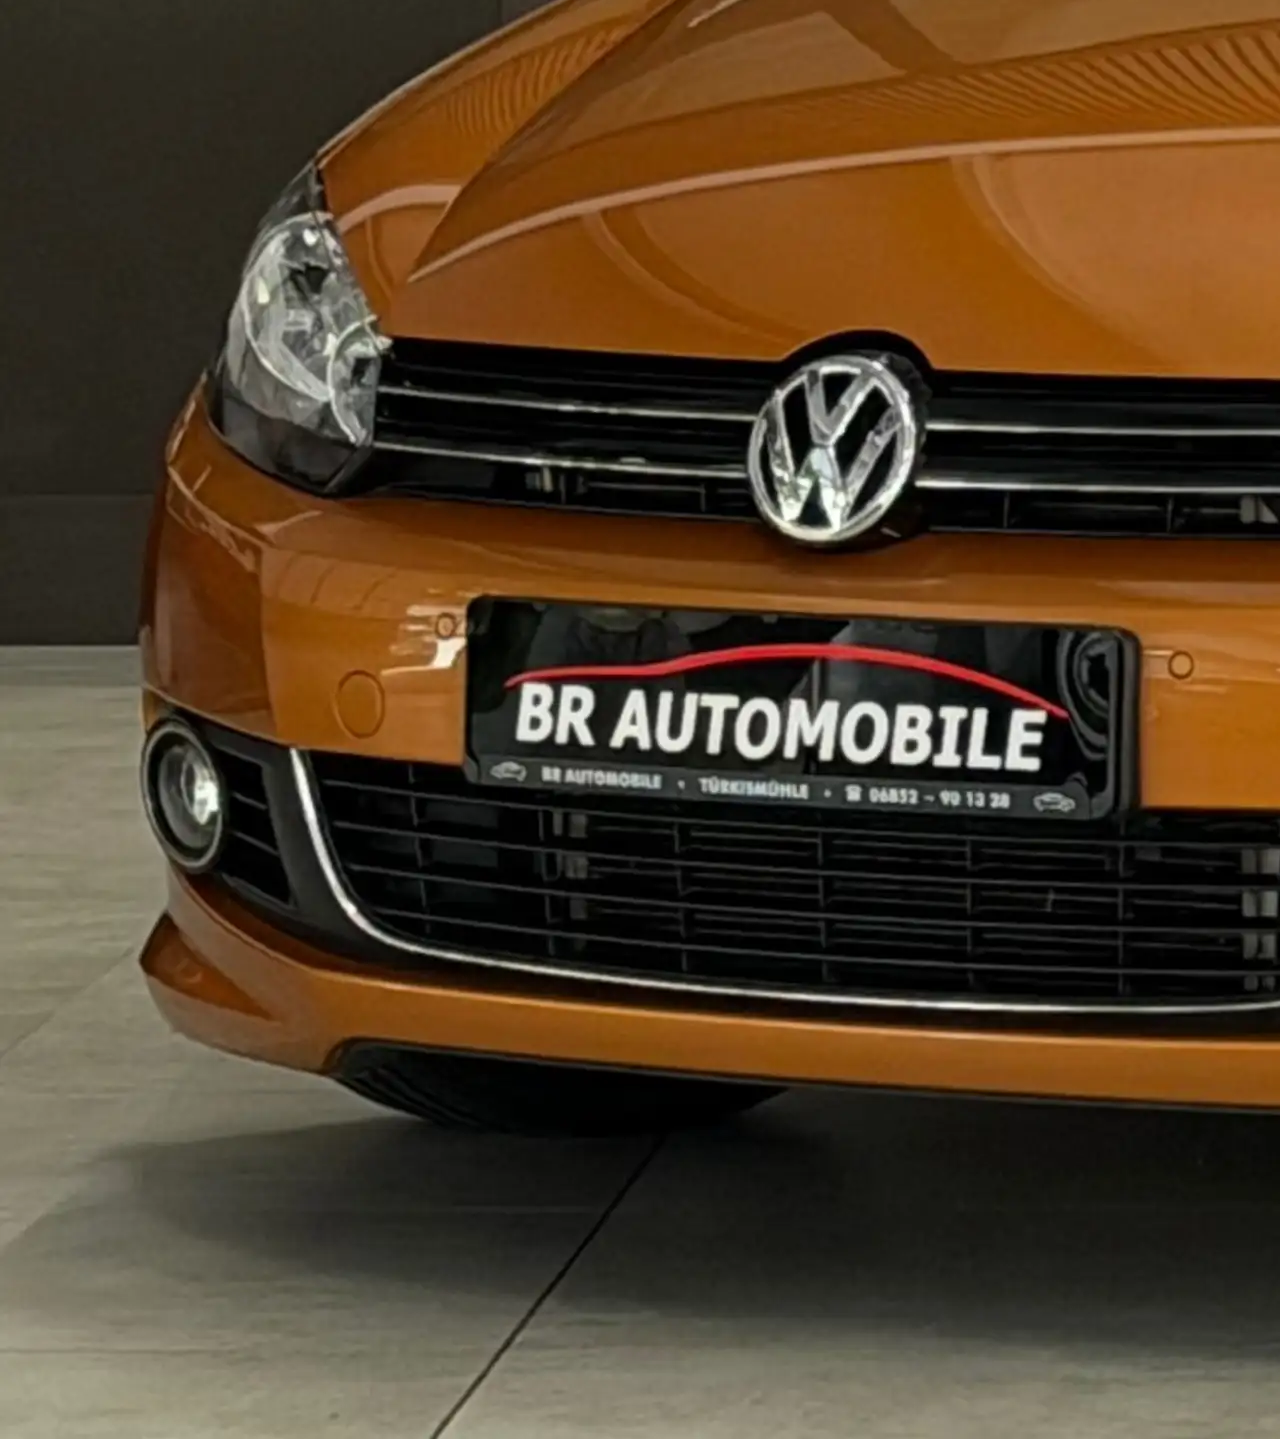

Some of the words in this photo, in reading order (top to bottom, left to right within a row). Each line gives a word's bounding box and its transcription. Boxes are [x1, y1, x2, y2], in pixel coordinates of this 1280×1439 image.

[515, 682, 595, 746] BR
[610, 689, 1048, 771] AUTOMOBILE
[541, 765, 562, 783] BR
[564, 768, 662, 789] AUTOMOBILE
